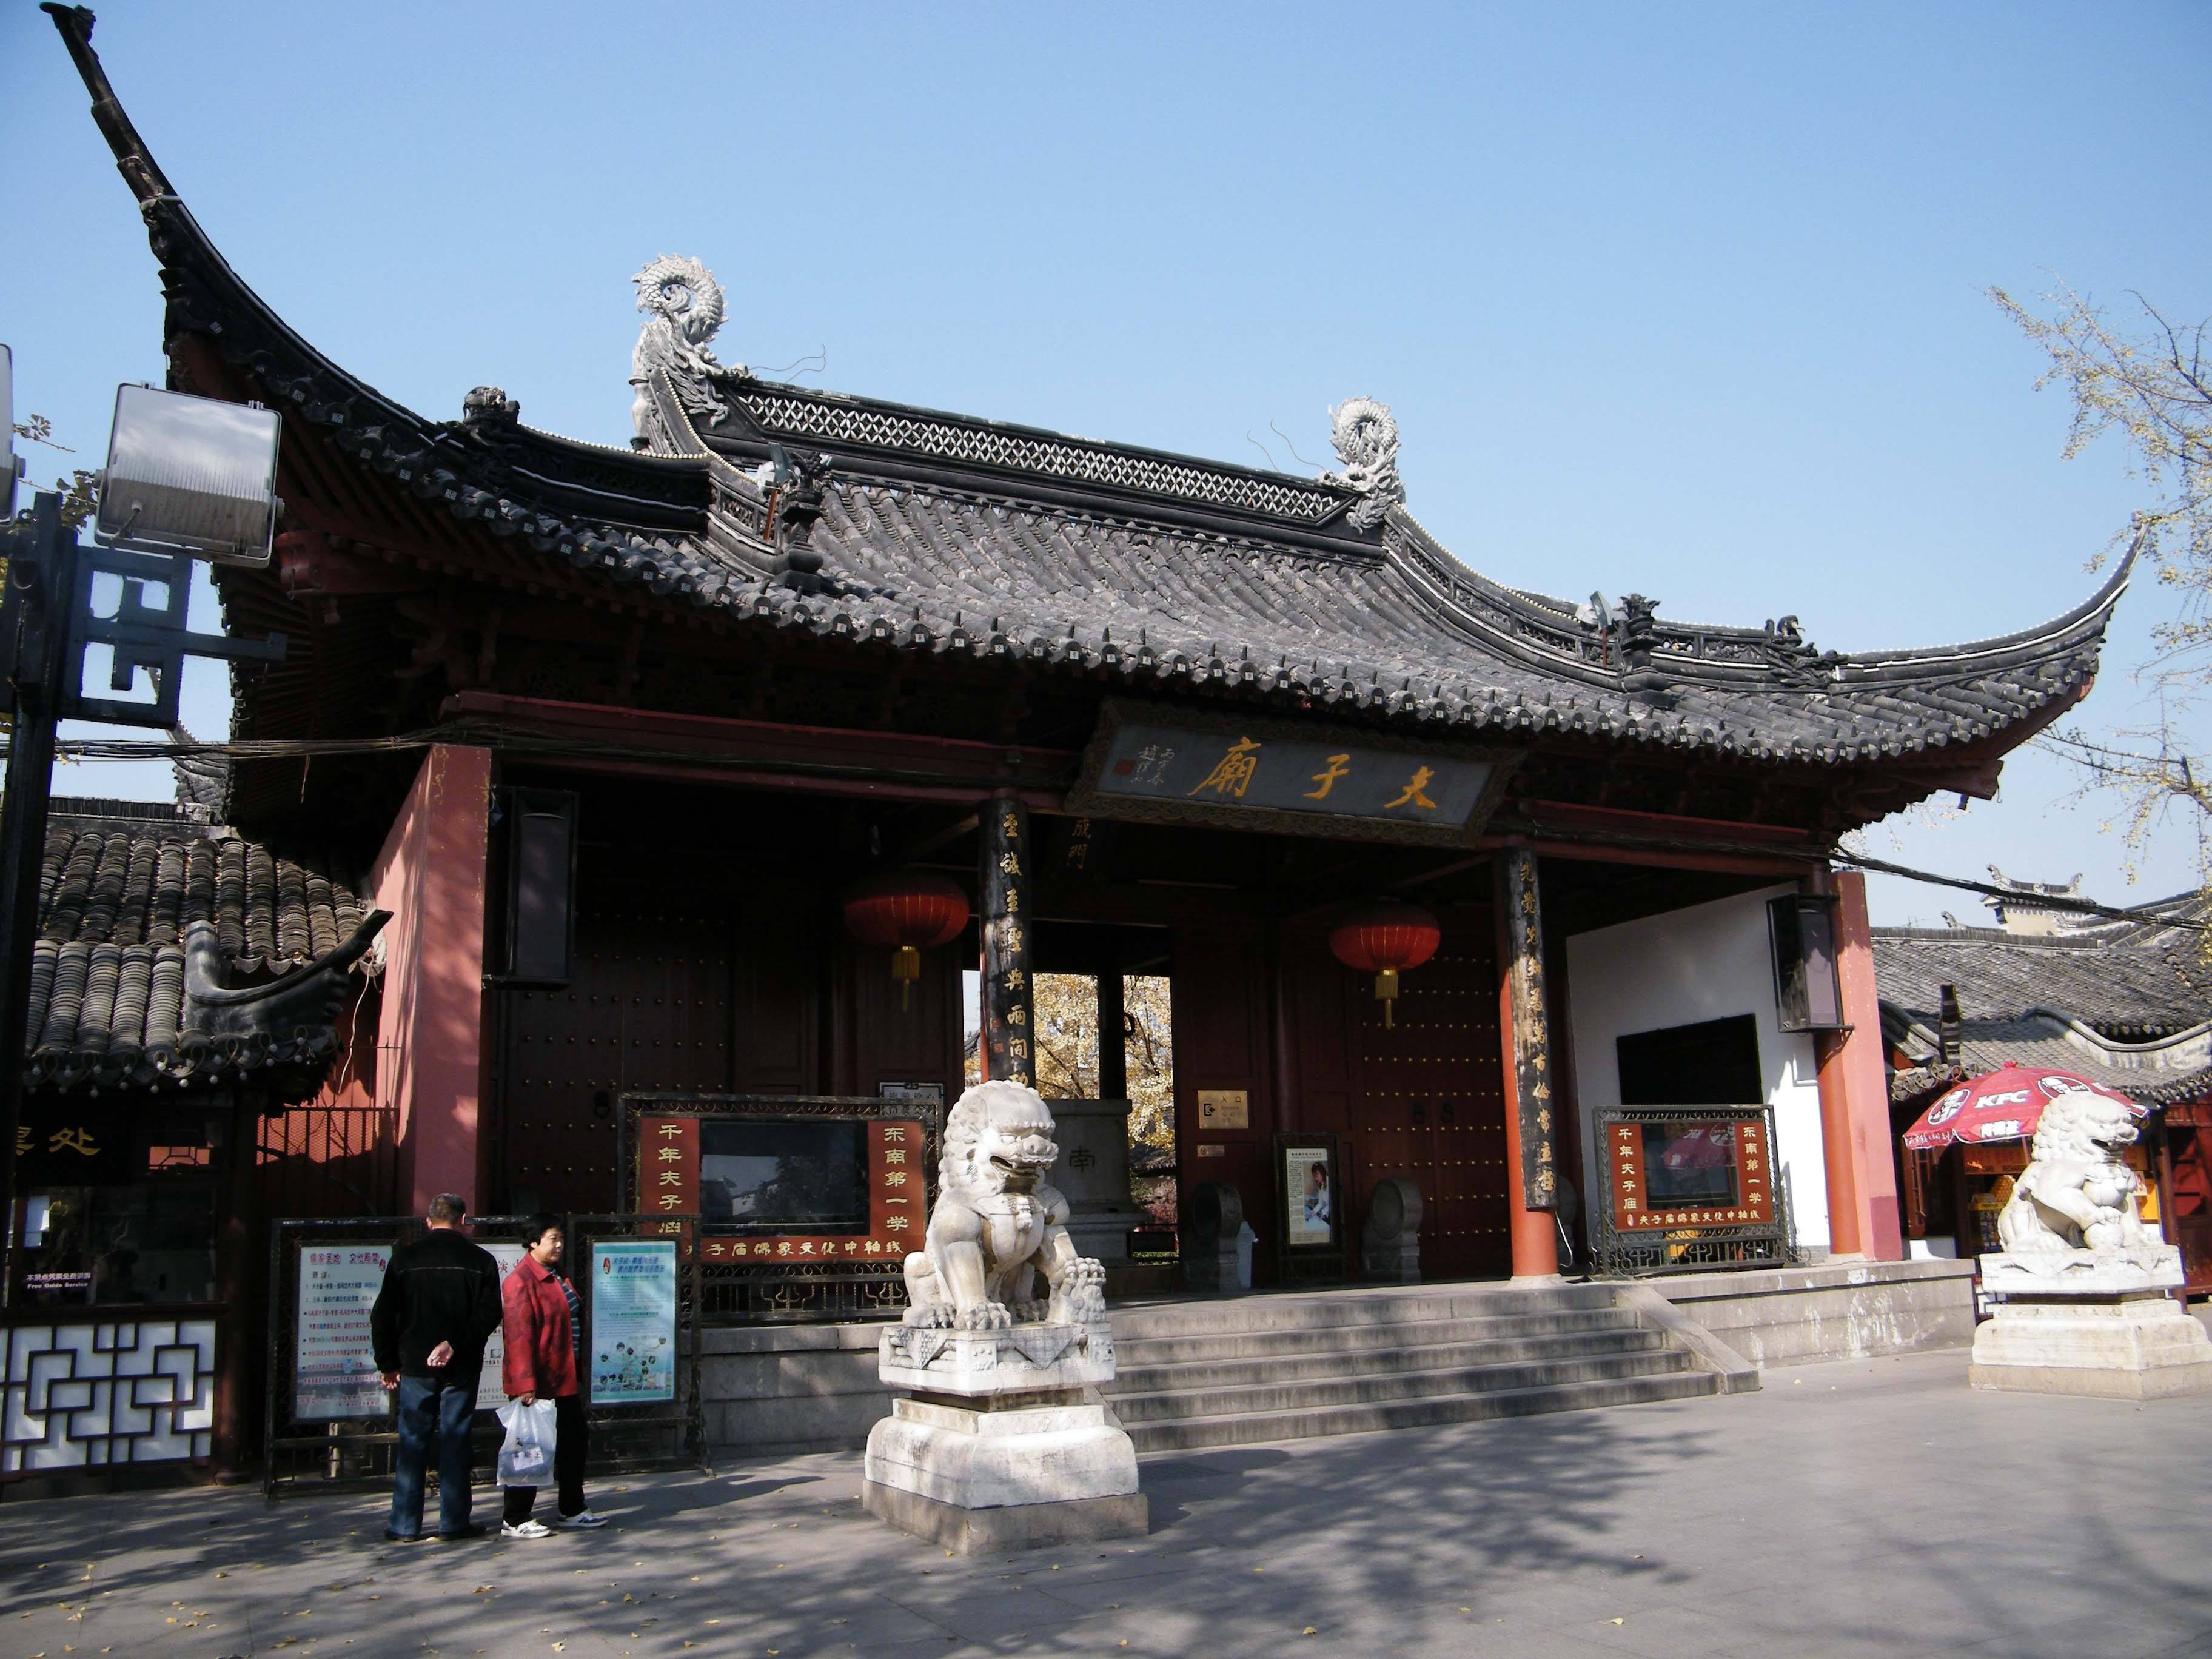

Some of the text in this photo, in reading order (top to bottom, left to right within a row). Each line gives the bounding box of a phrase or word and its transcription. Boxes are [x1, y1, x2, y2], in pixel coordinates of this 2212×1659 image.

[1188, 736, 1436, 809] 夫子廟
[1975, 1090, 2030, 1108] KFC
[883, 1127, 908, 1233] 东南第一学
[1618, 1128, 1637, 1211] 千年夫子庙
[1743, 1126, 1761, 1204] 东南第一学
[1638, 1210, 1761, 1226] 夫子庙儒家文化中轴线
